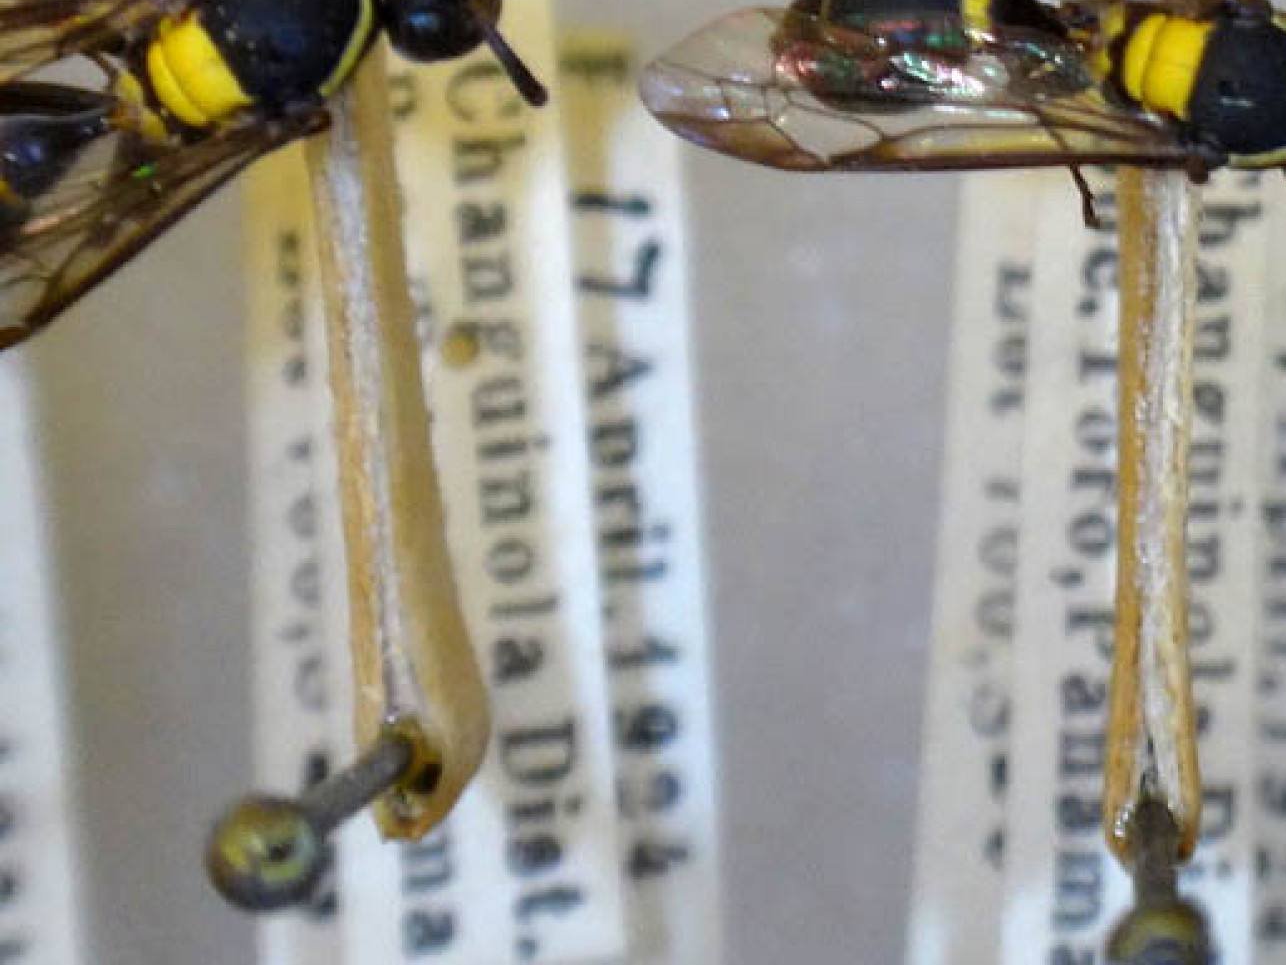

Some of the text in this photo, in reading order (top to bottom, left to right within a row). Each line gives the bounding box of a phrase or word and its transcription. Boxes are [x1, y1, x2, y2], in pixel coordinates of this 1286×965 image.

[571, 190, 664, 301] 17
[443, 62, 586, 957] Changuinola Dist.
